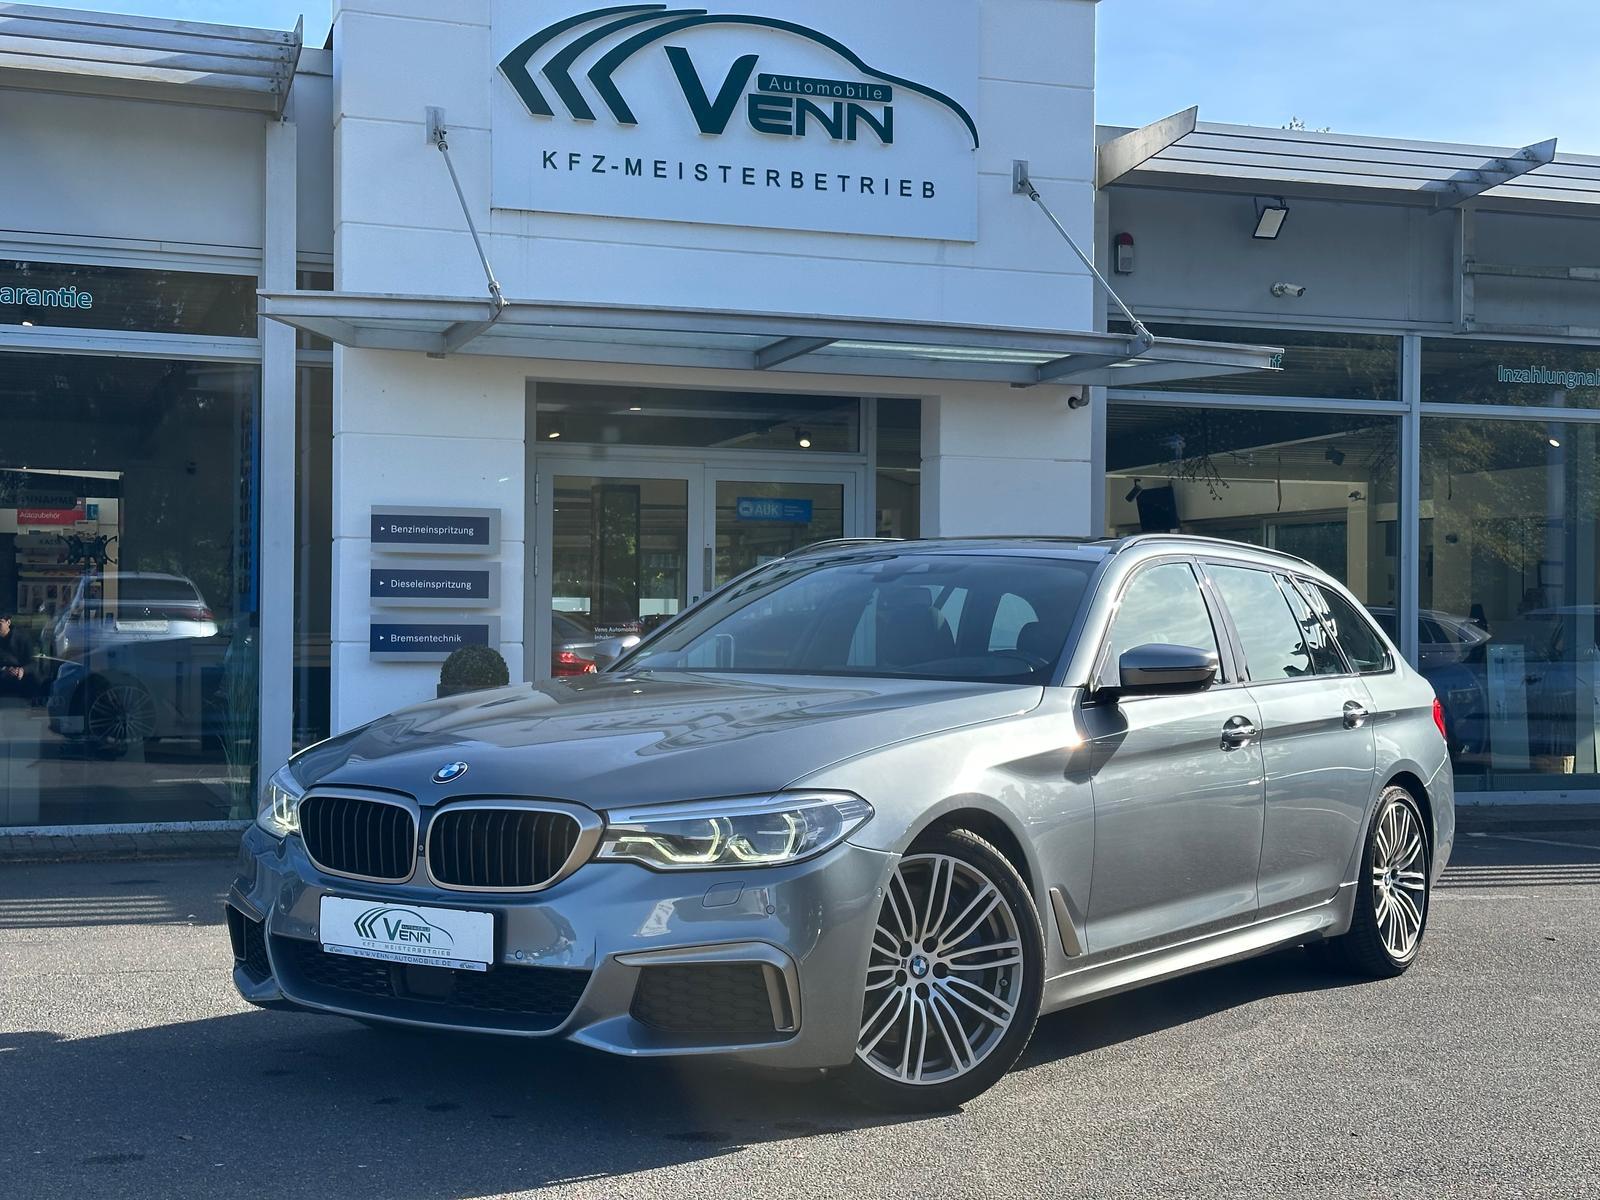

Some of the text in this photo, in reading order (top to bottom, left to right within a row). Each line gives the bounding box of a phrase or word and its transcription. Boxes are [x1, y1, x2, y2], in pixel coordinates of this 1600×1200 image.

[664, 45, 893, 145] VENN
[769, 76, 883, 100] Automobile
[542, 150, 936, 199] KFZ-MEISTERBETRIEB
[390, 524, 474, 536] Benzineinspritzung
[390, 579, 472, 590] Dieseleinspritzung
[390, 633, 462, 643] Bremsentechnik
[383, 917, 431, 943] VENN
